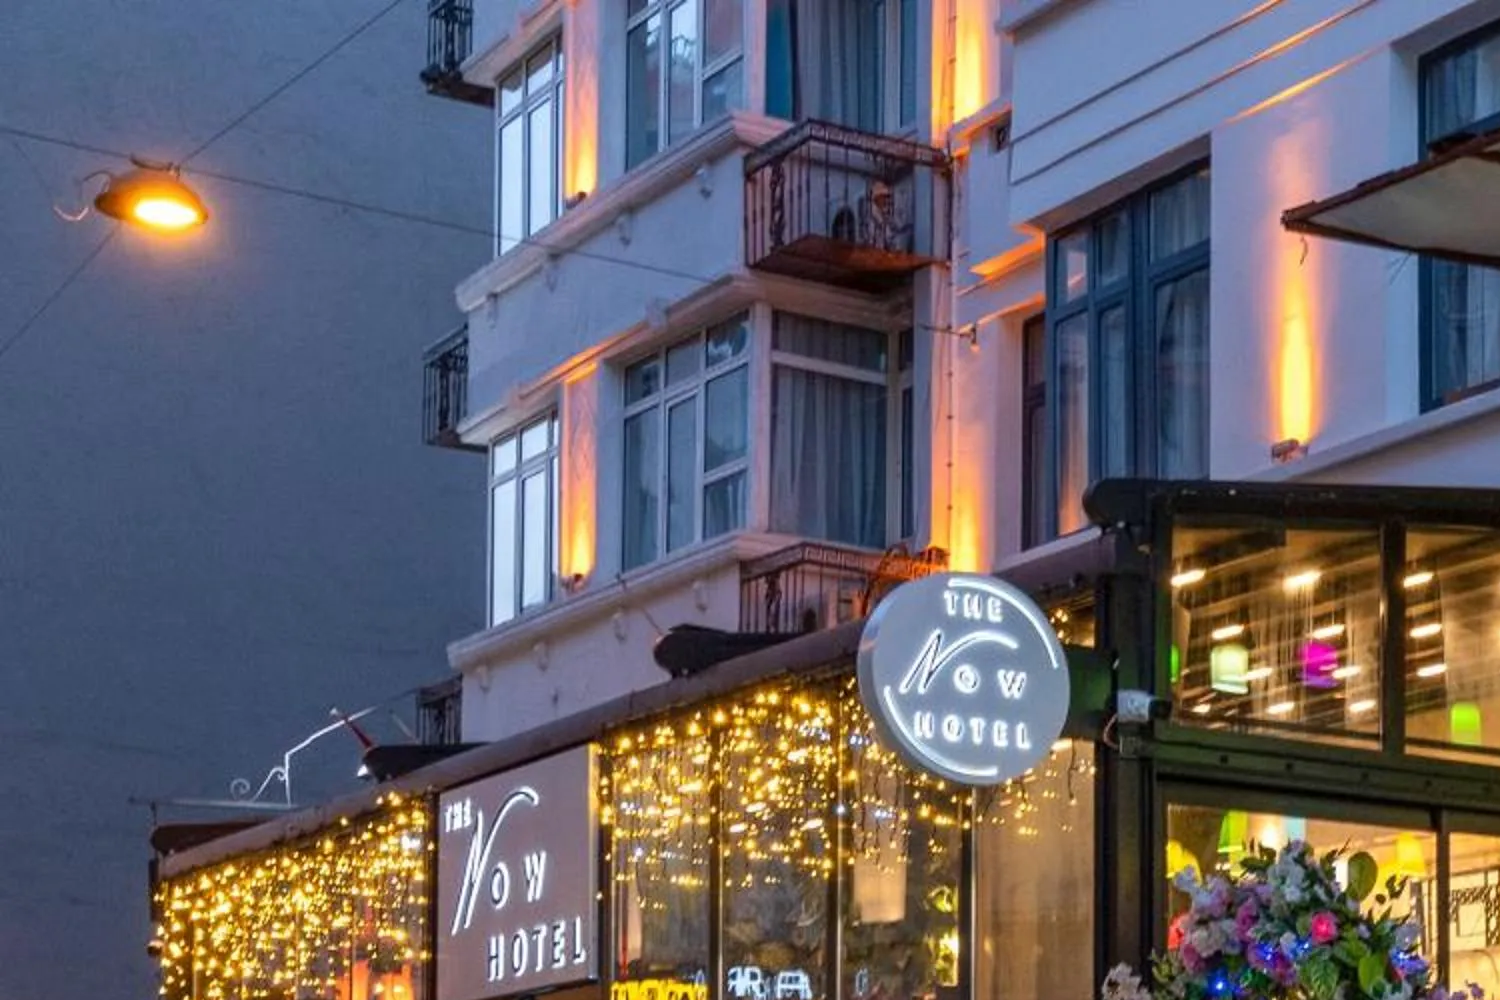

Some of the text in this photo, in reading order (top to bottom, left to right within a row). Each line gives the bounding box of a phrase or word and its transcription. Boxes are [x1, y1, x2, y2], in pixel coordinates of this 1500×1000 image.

[943, 589, 1003, 623] THE
[912, 710, 1032, 751] HOTEL
[444, 797, 474, 833] THE
[487, 915, 588, 982] HOTEL
